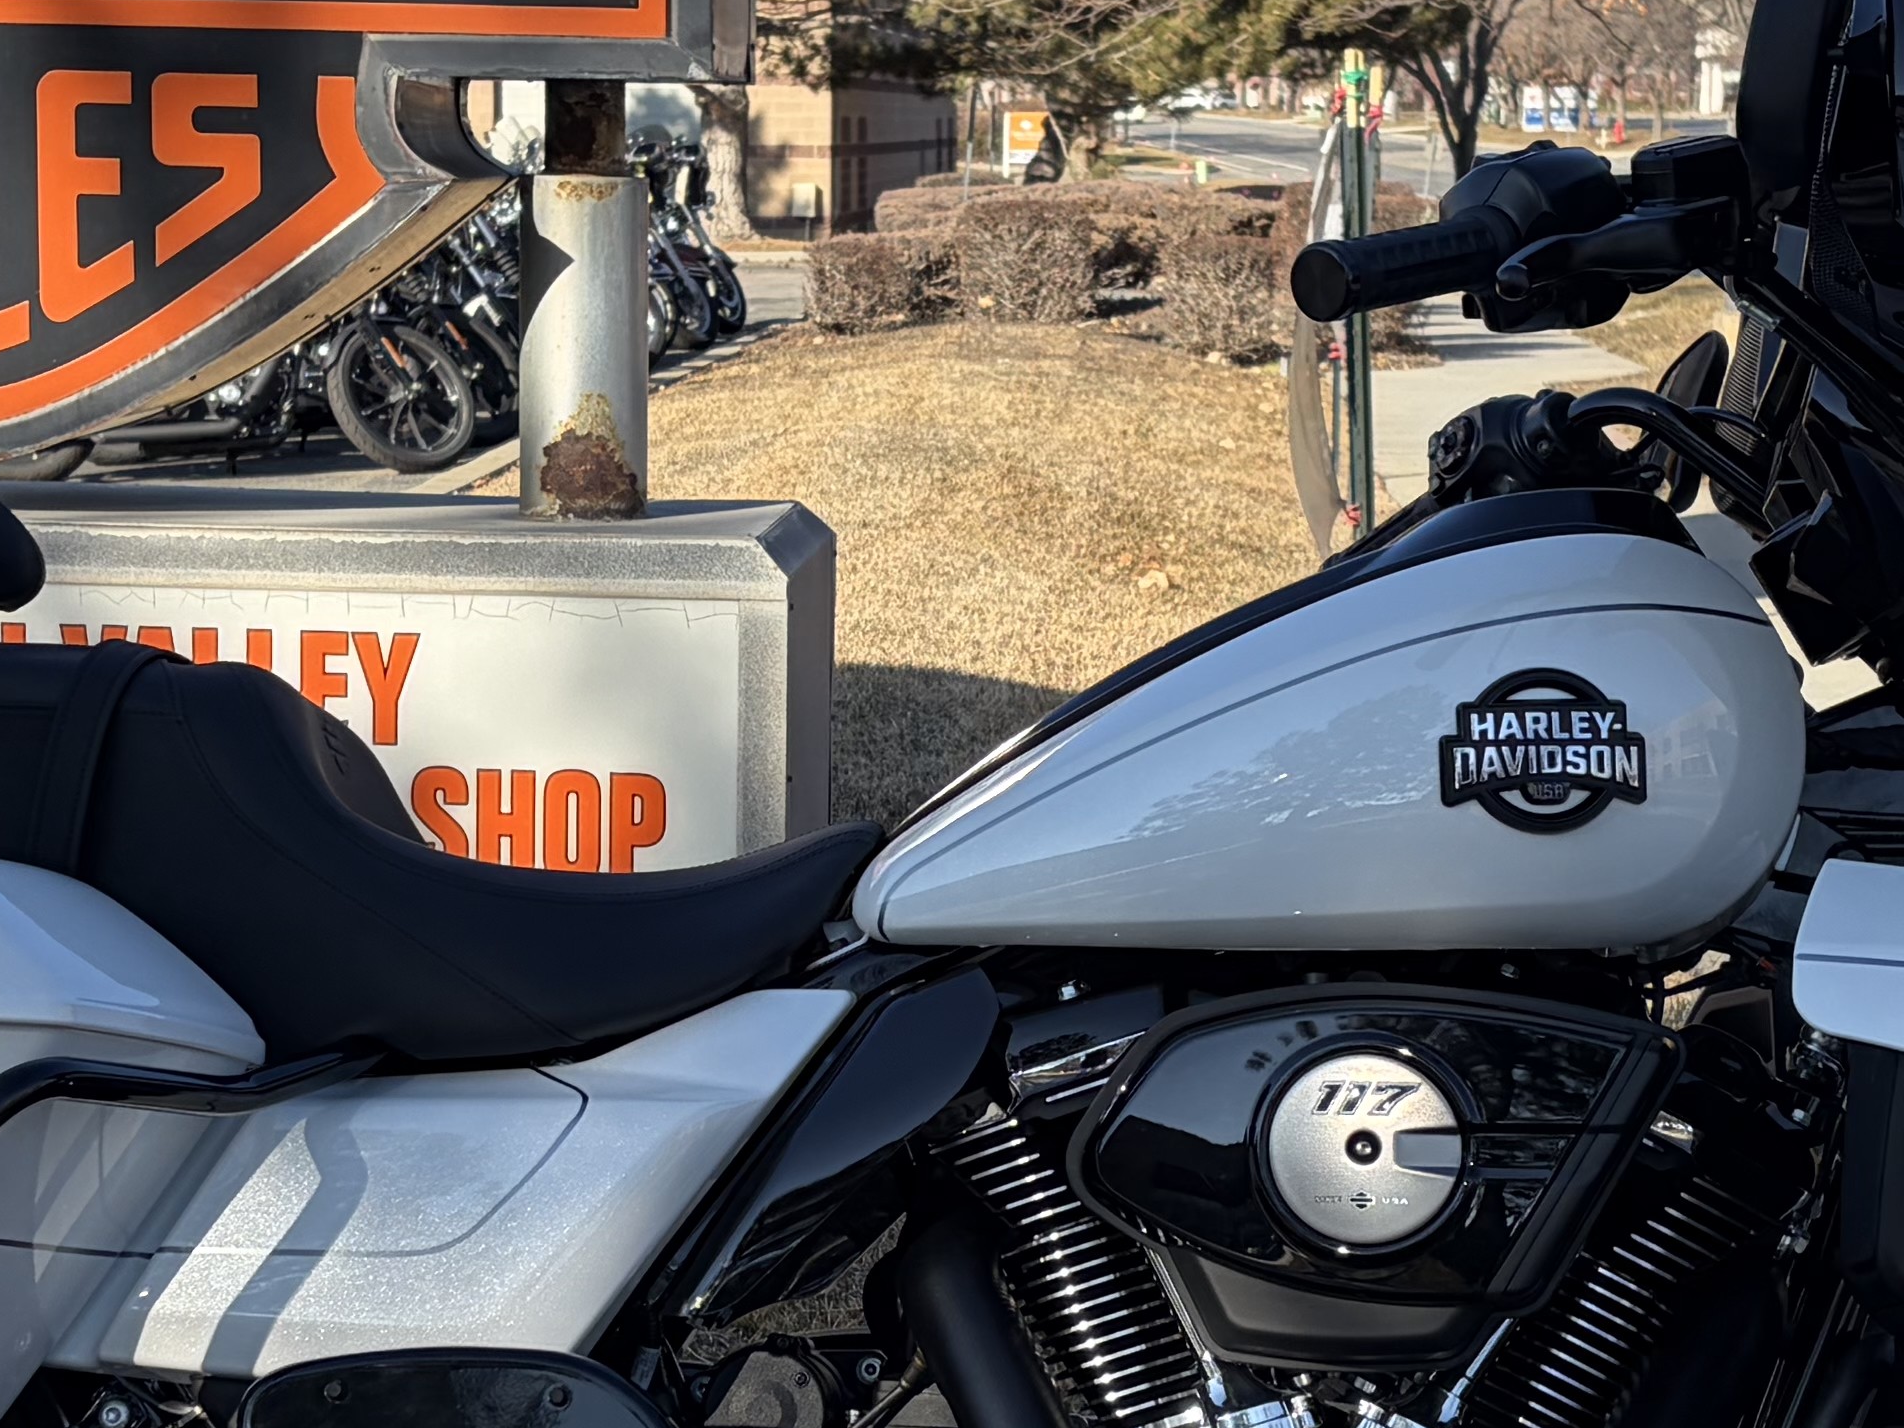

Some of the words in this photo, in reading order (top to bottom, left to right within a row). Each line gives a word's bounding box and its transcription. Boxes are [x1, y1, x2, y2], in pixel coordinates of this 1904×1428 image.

[1470, 711, 1623, 741] HARLEY-
[1453, 745, 1640, 789] DAVIDSON
[1532, 782, 1565, 800] USA
[411, 765, 667, 873] SHOP
[1311, 1080, 1422, 1116] 117
